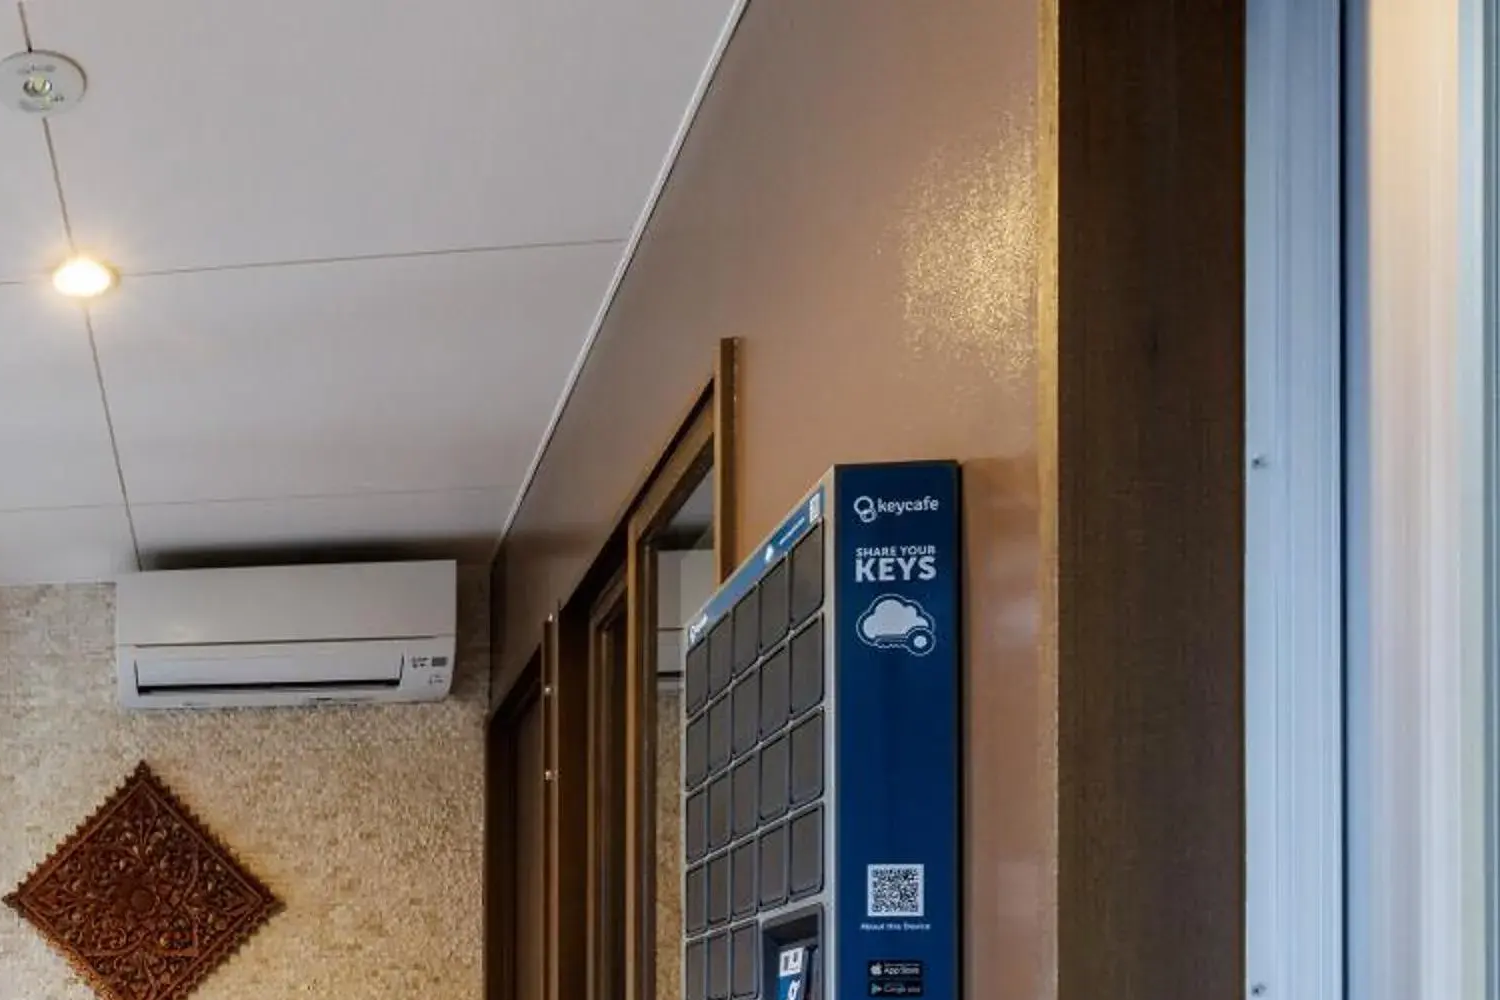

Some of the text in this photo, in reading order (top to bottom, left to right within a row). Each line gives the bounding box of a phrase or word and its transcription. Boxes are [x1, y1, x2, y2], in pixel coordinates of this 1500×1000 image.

[877, 495, 940, 516] keycafe
[855, 545, 936, 557] SHARE YOUR
[854, 556, 937, 583] KEYS
